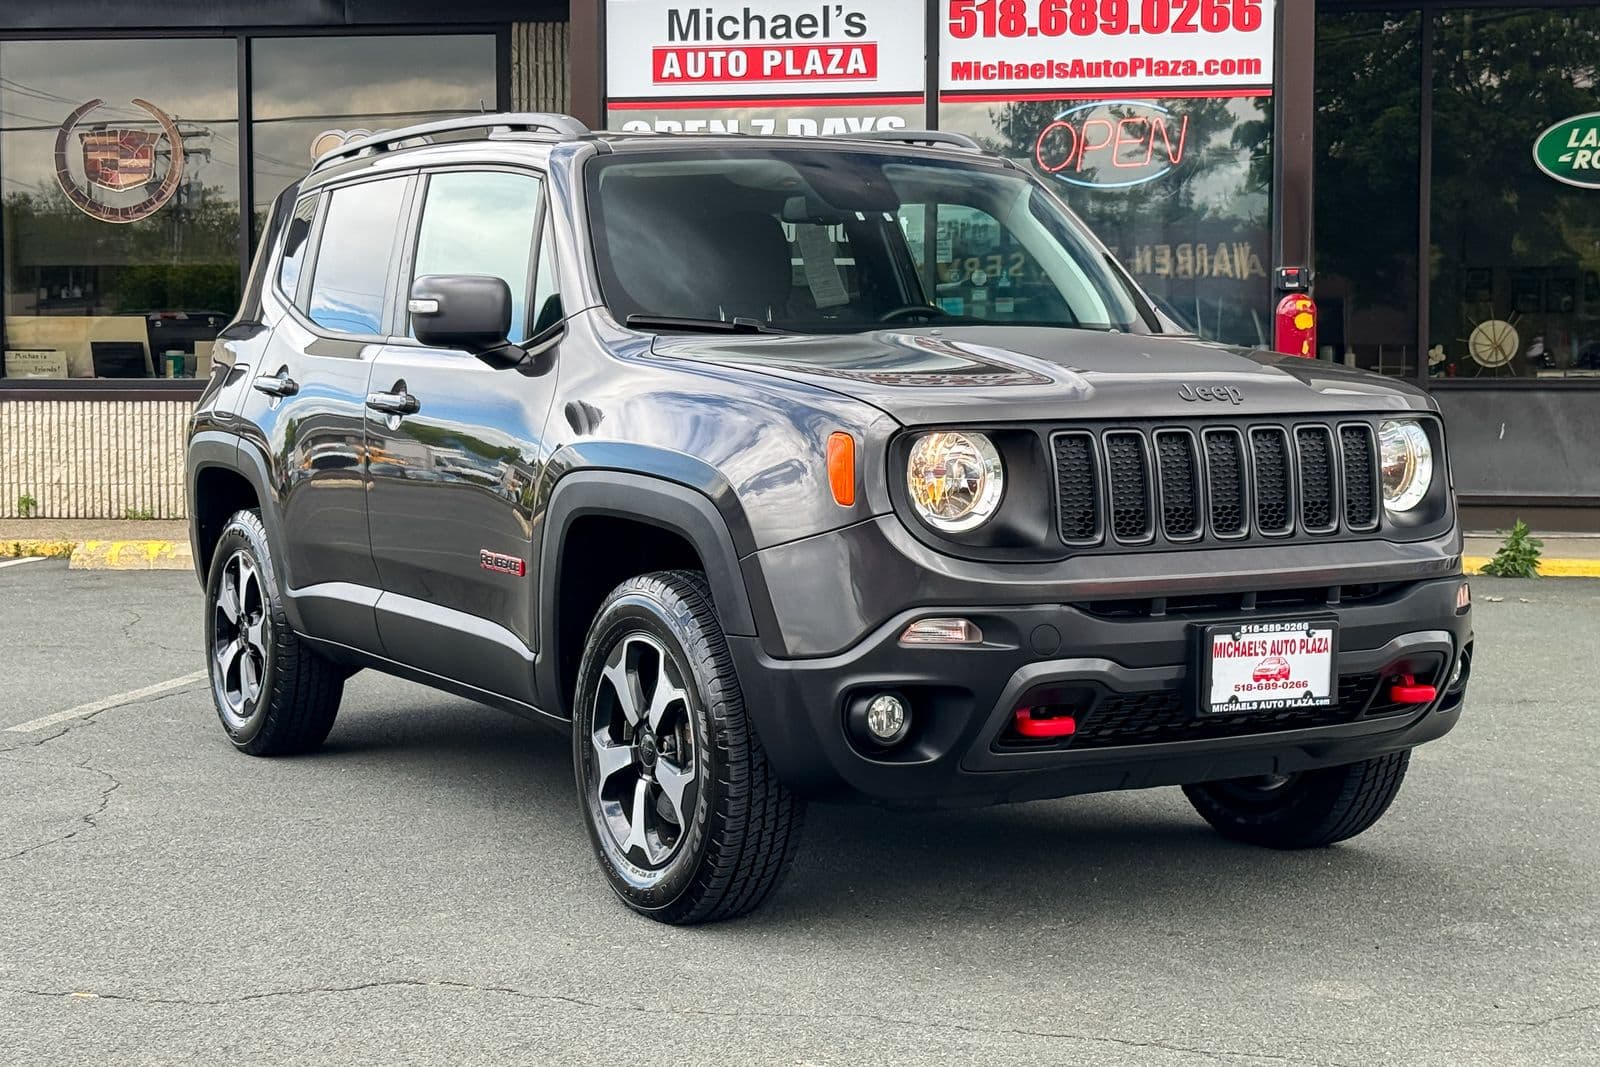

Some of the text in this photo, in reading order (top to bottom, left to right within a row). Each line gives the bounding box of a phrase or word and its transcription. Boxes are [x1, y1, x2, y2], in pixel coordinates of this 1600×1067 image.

[667, 5, 868, 42] Michael's
[949, 0, 1263, 39] 518.689.0266
[660, 47, 868, 79] AUTO PLAZA
[950, 57, 1262, 82] MichaelsAutoPlaza.com
[1035, 114, 1188, 174] OPEN
[1178, 383, 1244, 405] Jeep
[1213, 637, 1329, 658] MICHAEL'S AUTO PLAZA
[1234, 680, 1309, 692] 518-689-0266
[1211, 701, 1258, 713] MICHAELS
[1259, 700, 1284, 710] AUTO
